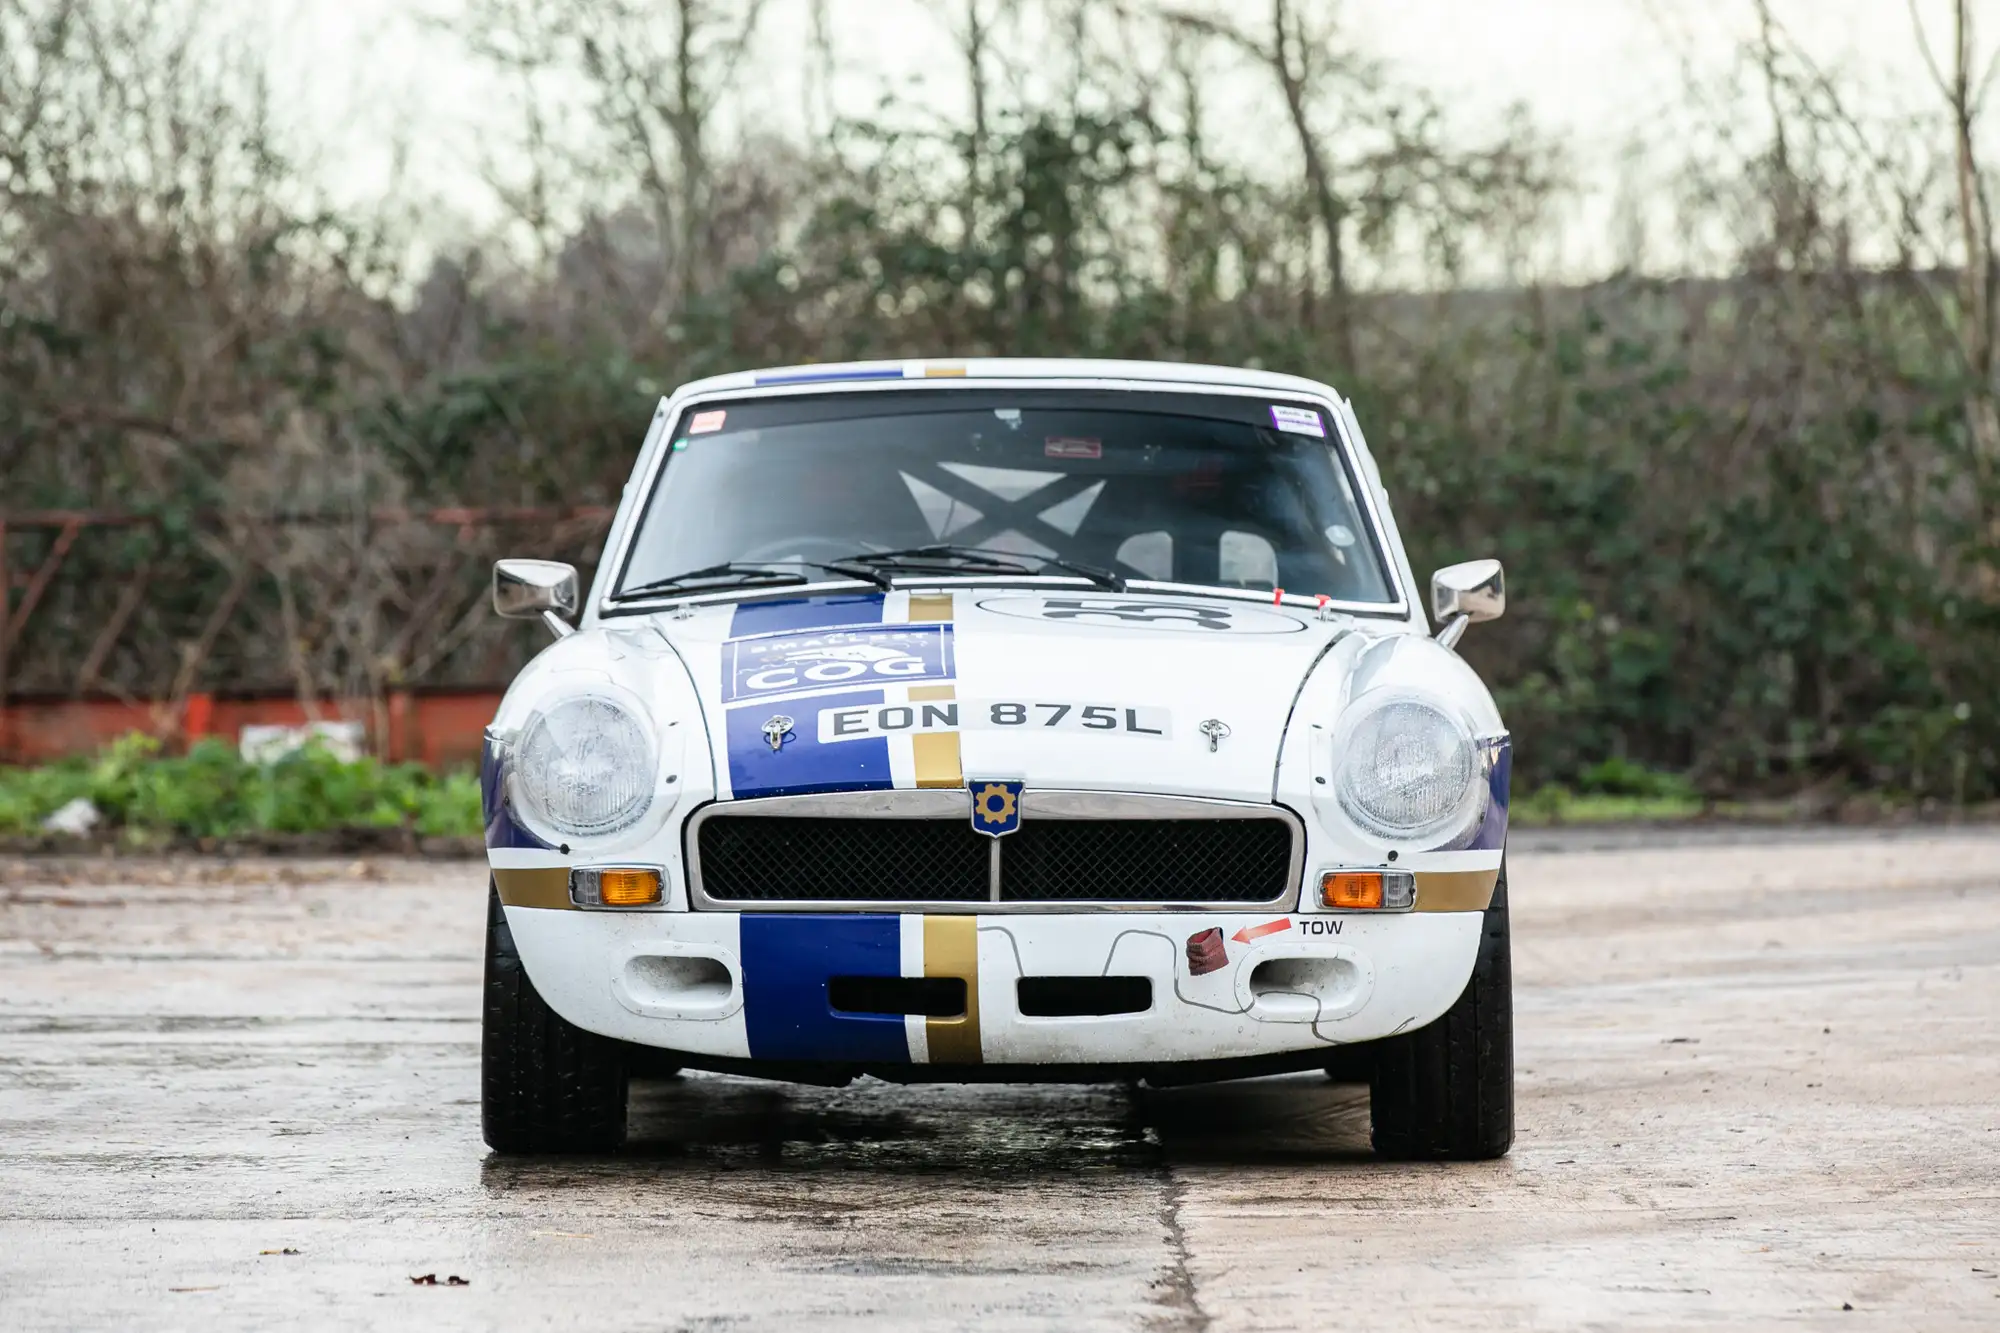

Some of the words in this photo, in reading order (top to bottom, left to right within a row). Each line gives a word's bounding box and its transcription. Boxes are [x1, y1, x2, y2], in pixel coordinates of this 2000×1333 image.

[746, 657, 926, 689] COG
[833, 703, 958, 736] EON
[990, 702, 1162, 735] 875L
[1299, 920, 1344, 935] TOW
